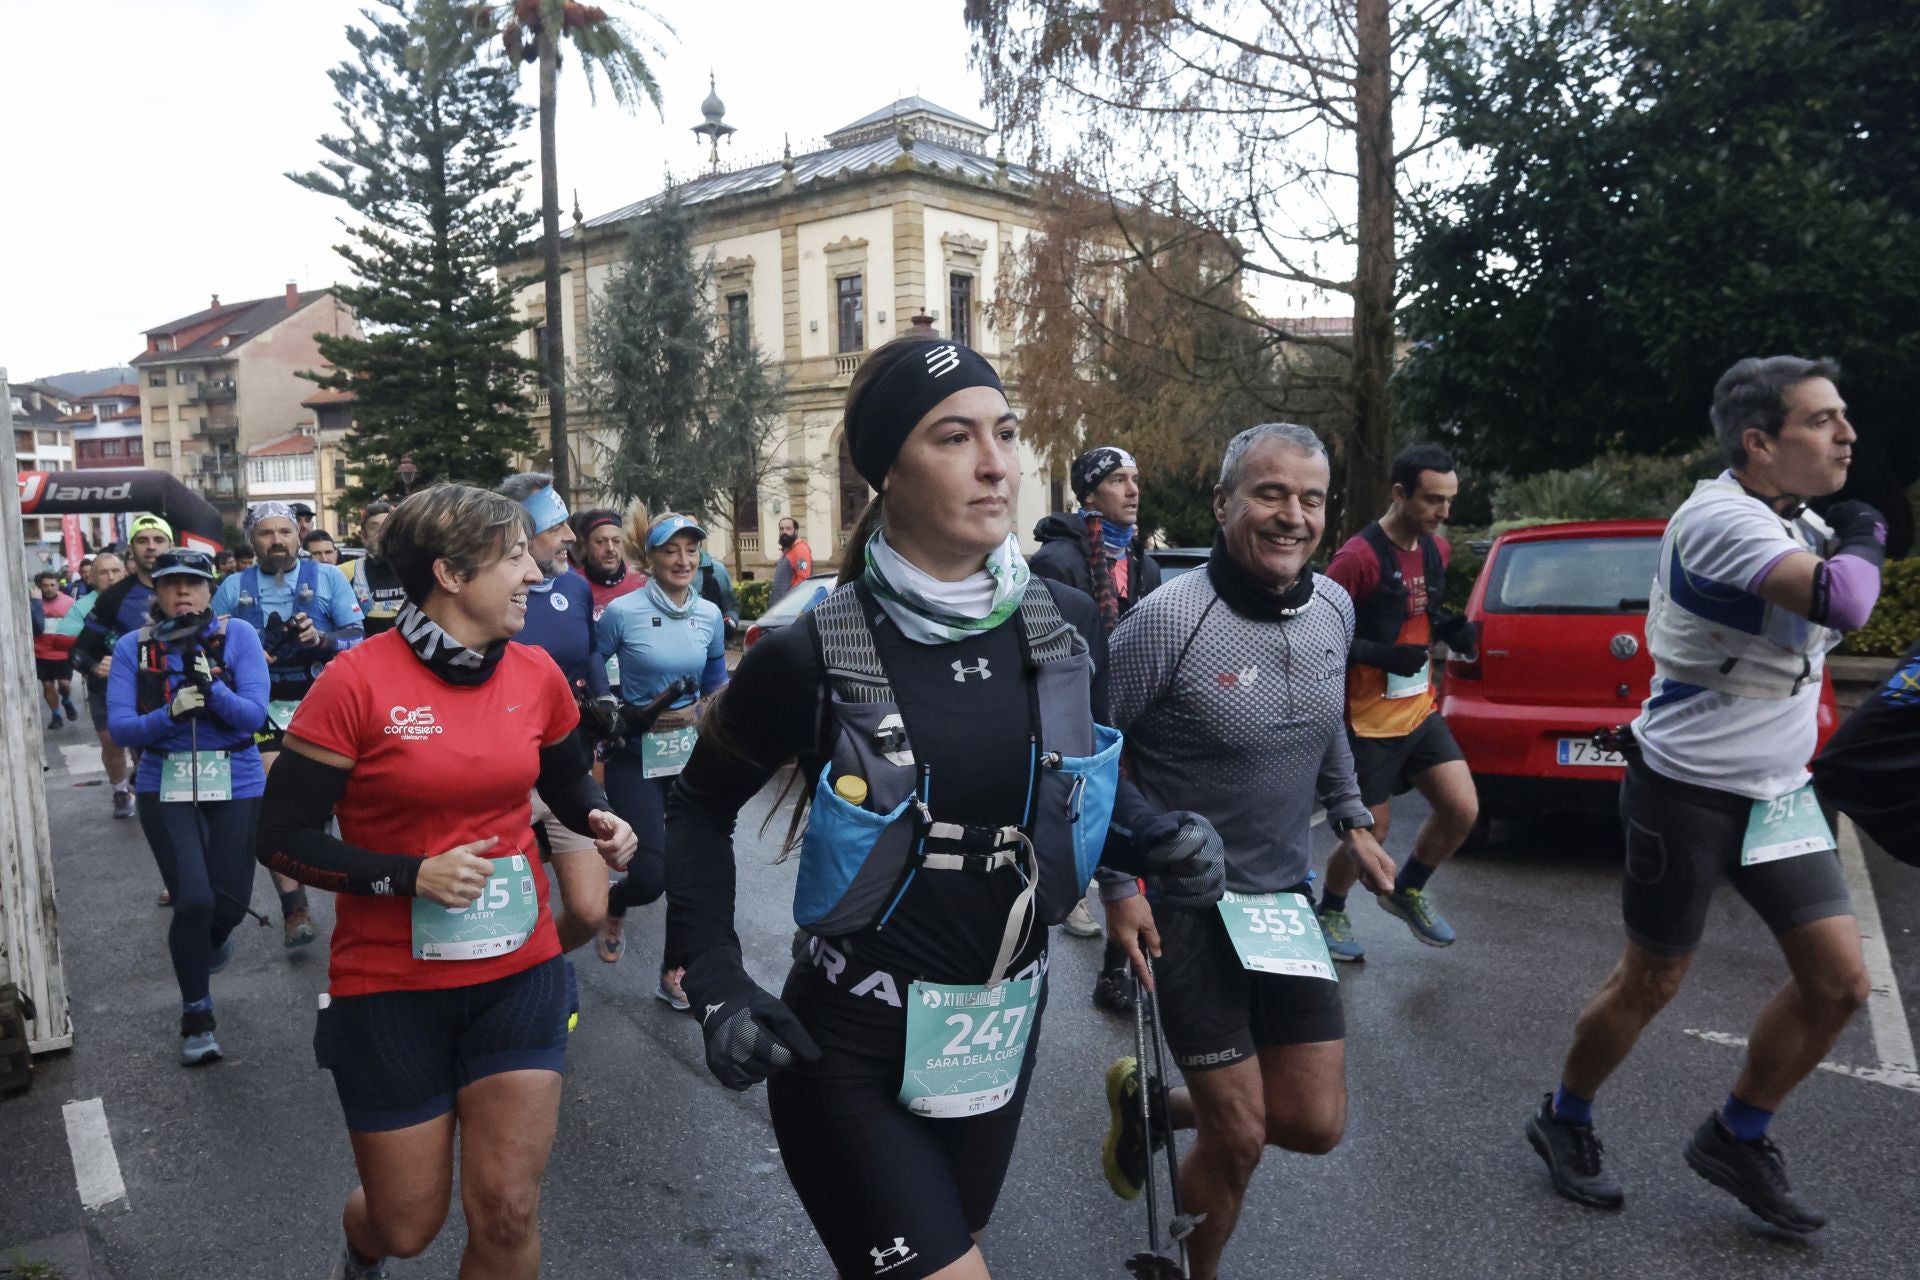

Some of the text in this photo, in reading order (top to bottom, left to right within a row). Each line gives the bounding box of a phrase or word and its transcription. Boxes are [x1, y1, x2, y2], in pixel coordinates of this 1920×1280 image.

[45, 482, 132, 501] land
[1315, 665, 1345, 682] LURBE
[384, 725, 443, 734] corresiero
[656, 735, 691, 756] 256
[1573, 742, 1626, 762] 732
[174, 761, 218, 778] 304
[446, 877, 510, 914] 15
[464, 911, 495, 921] PATRY
[1242, 907, 1306, 936] 353
[942, 1005, 1027, 1056] 247
[926, 1057, 960, 1069] SARA
[962, 1053, 993, 1066] DELA
